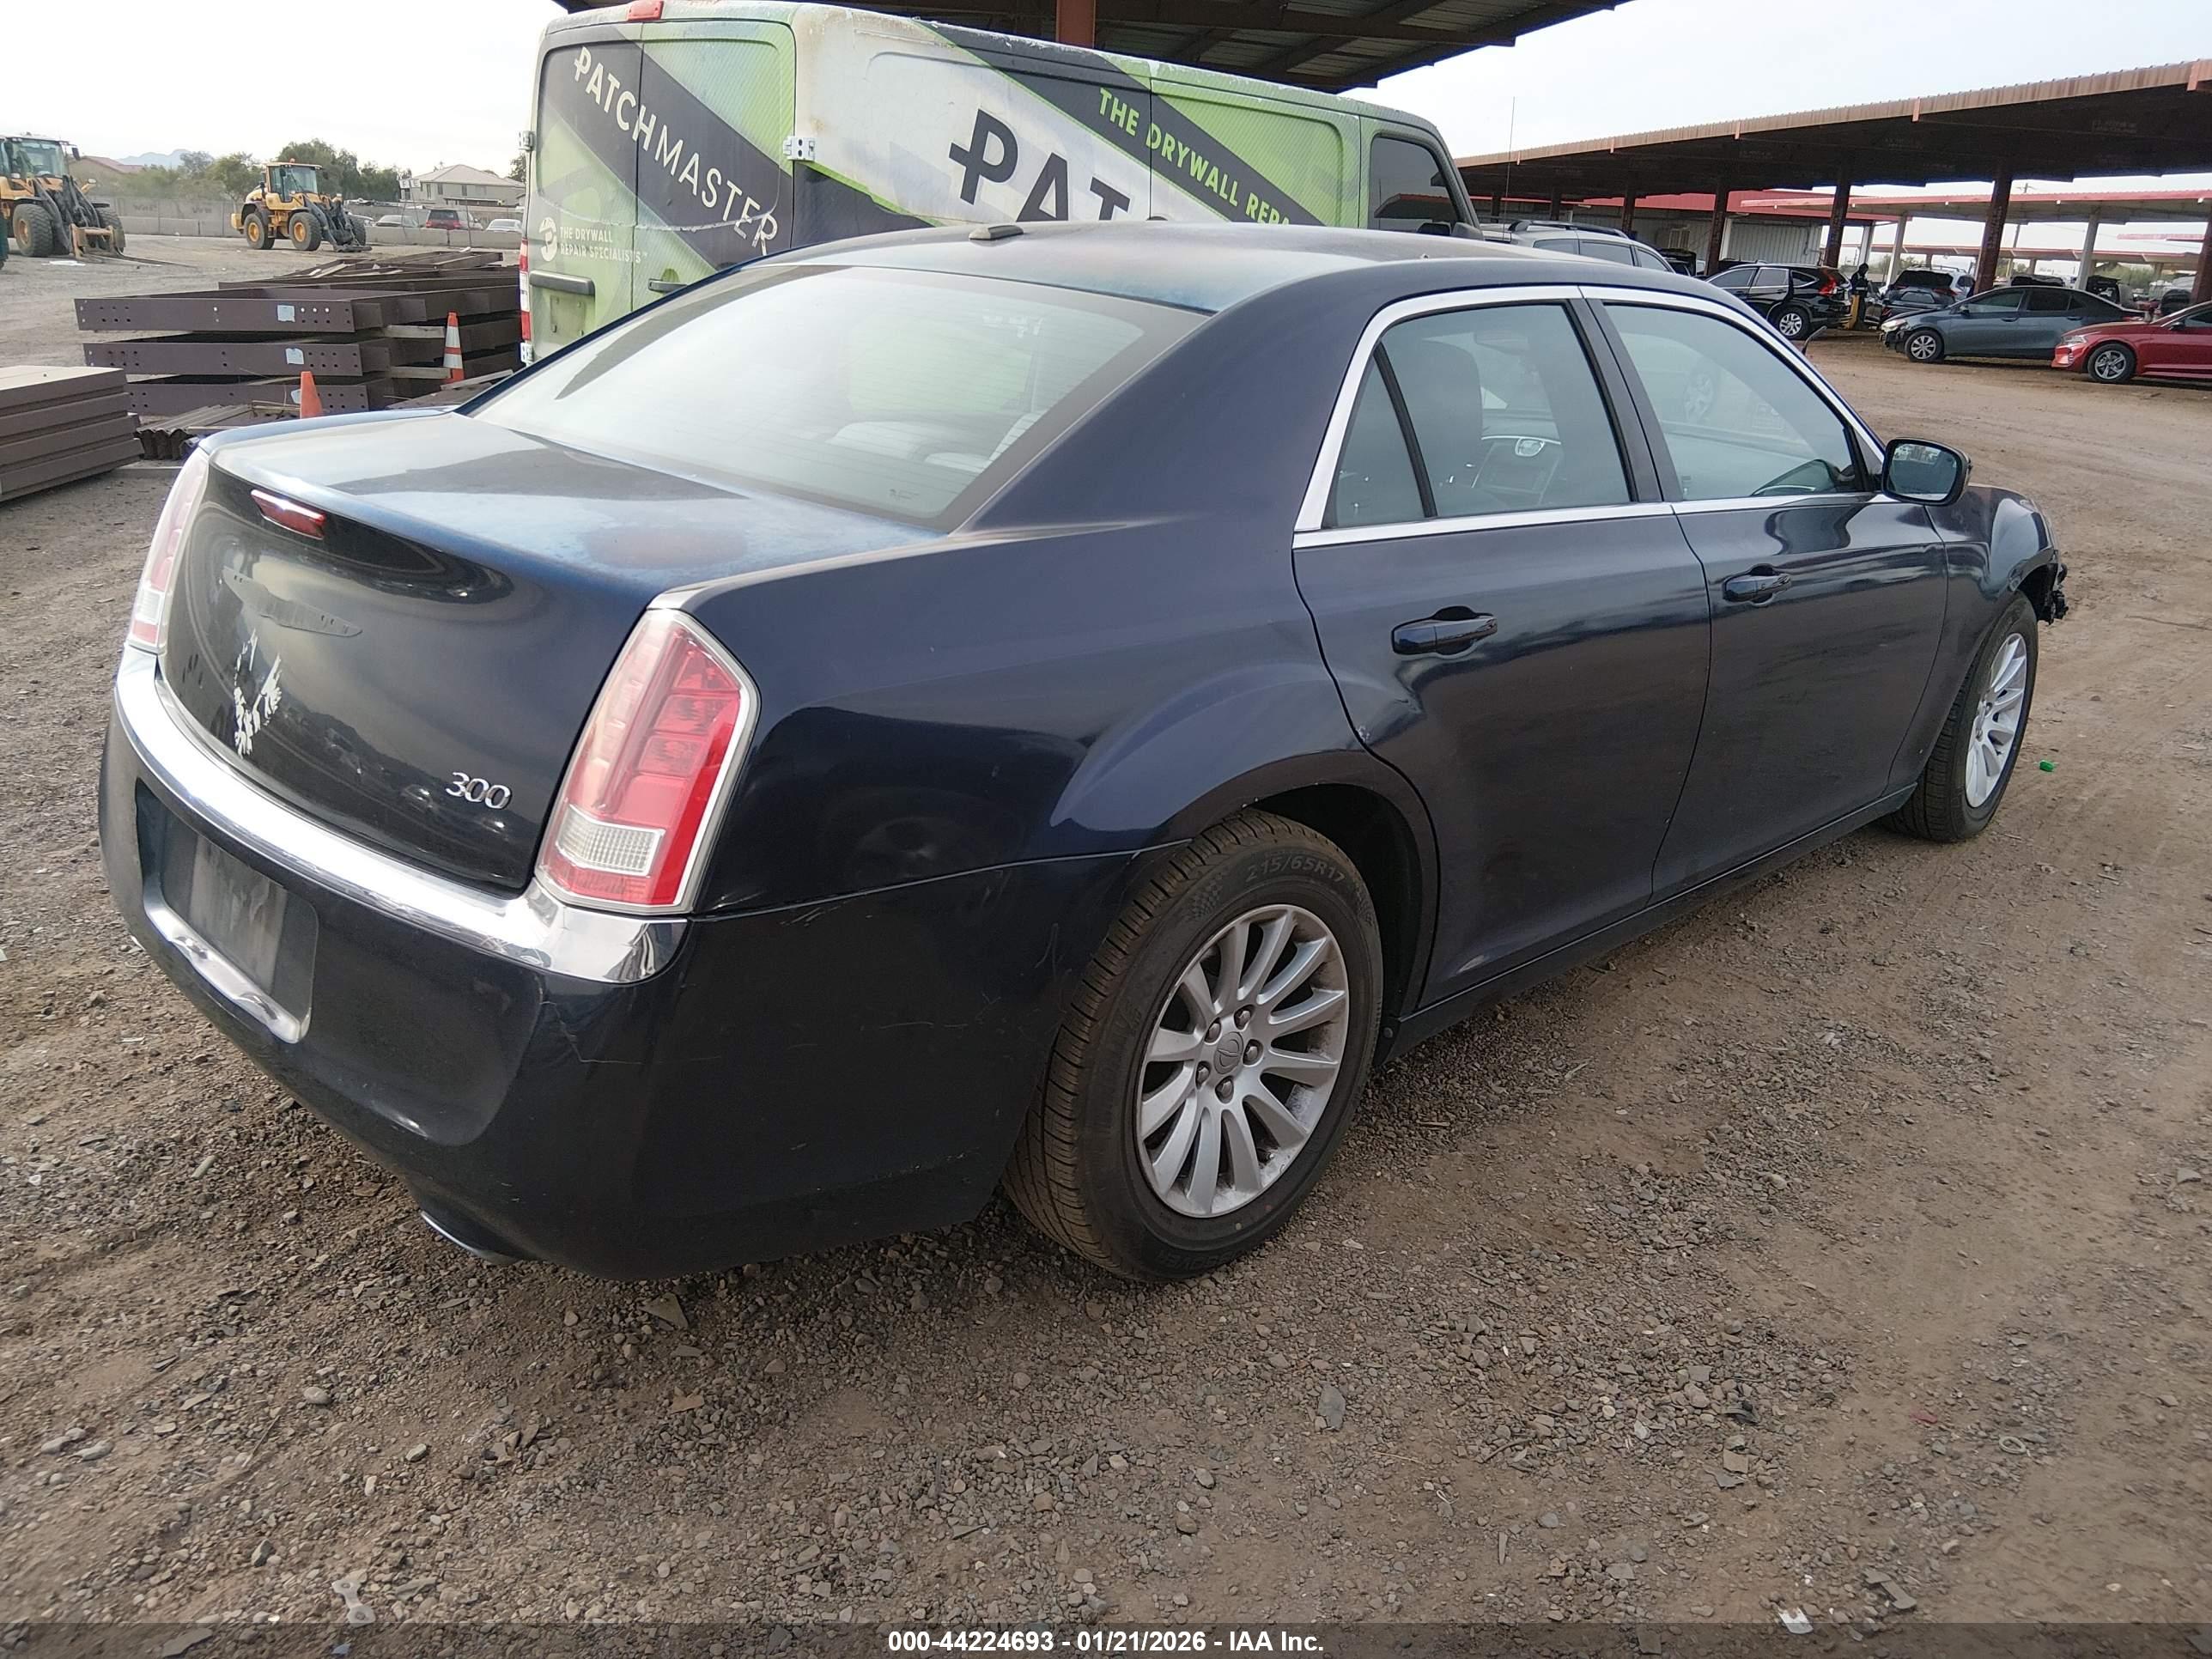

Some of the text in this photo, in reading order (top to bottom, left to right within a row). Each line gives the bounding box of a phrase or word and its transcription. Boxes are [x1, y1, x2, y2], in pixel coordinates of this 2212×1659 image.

[574, 46, 778, 256] PATCHMASTER
[1100, 88, 1139, 136] THE
[1146, 123, 1237, 206] DRYWALL
[560, 226, 613, 243] THE DRYWALL
[560, 243, 586, 257] REPAIR
[446, 771, 512, 809] 300
[1246, 855, 1346, 882] 215/65R17
